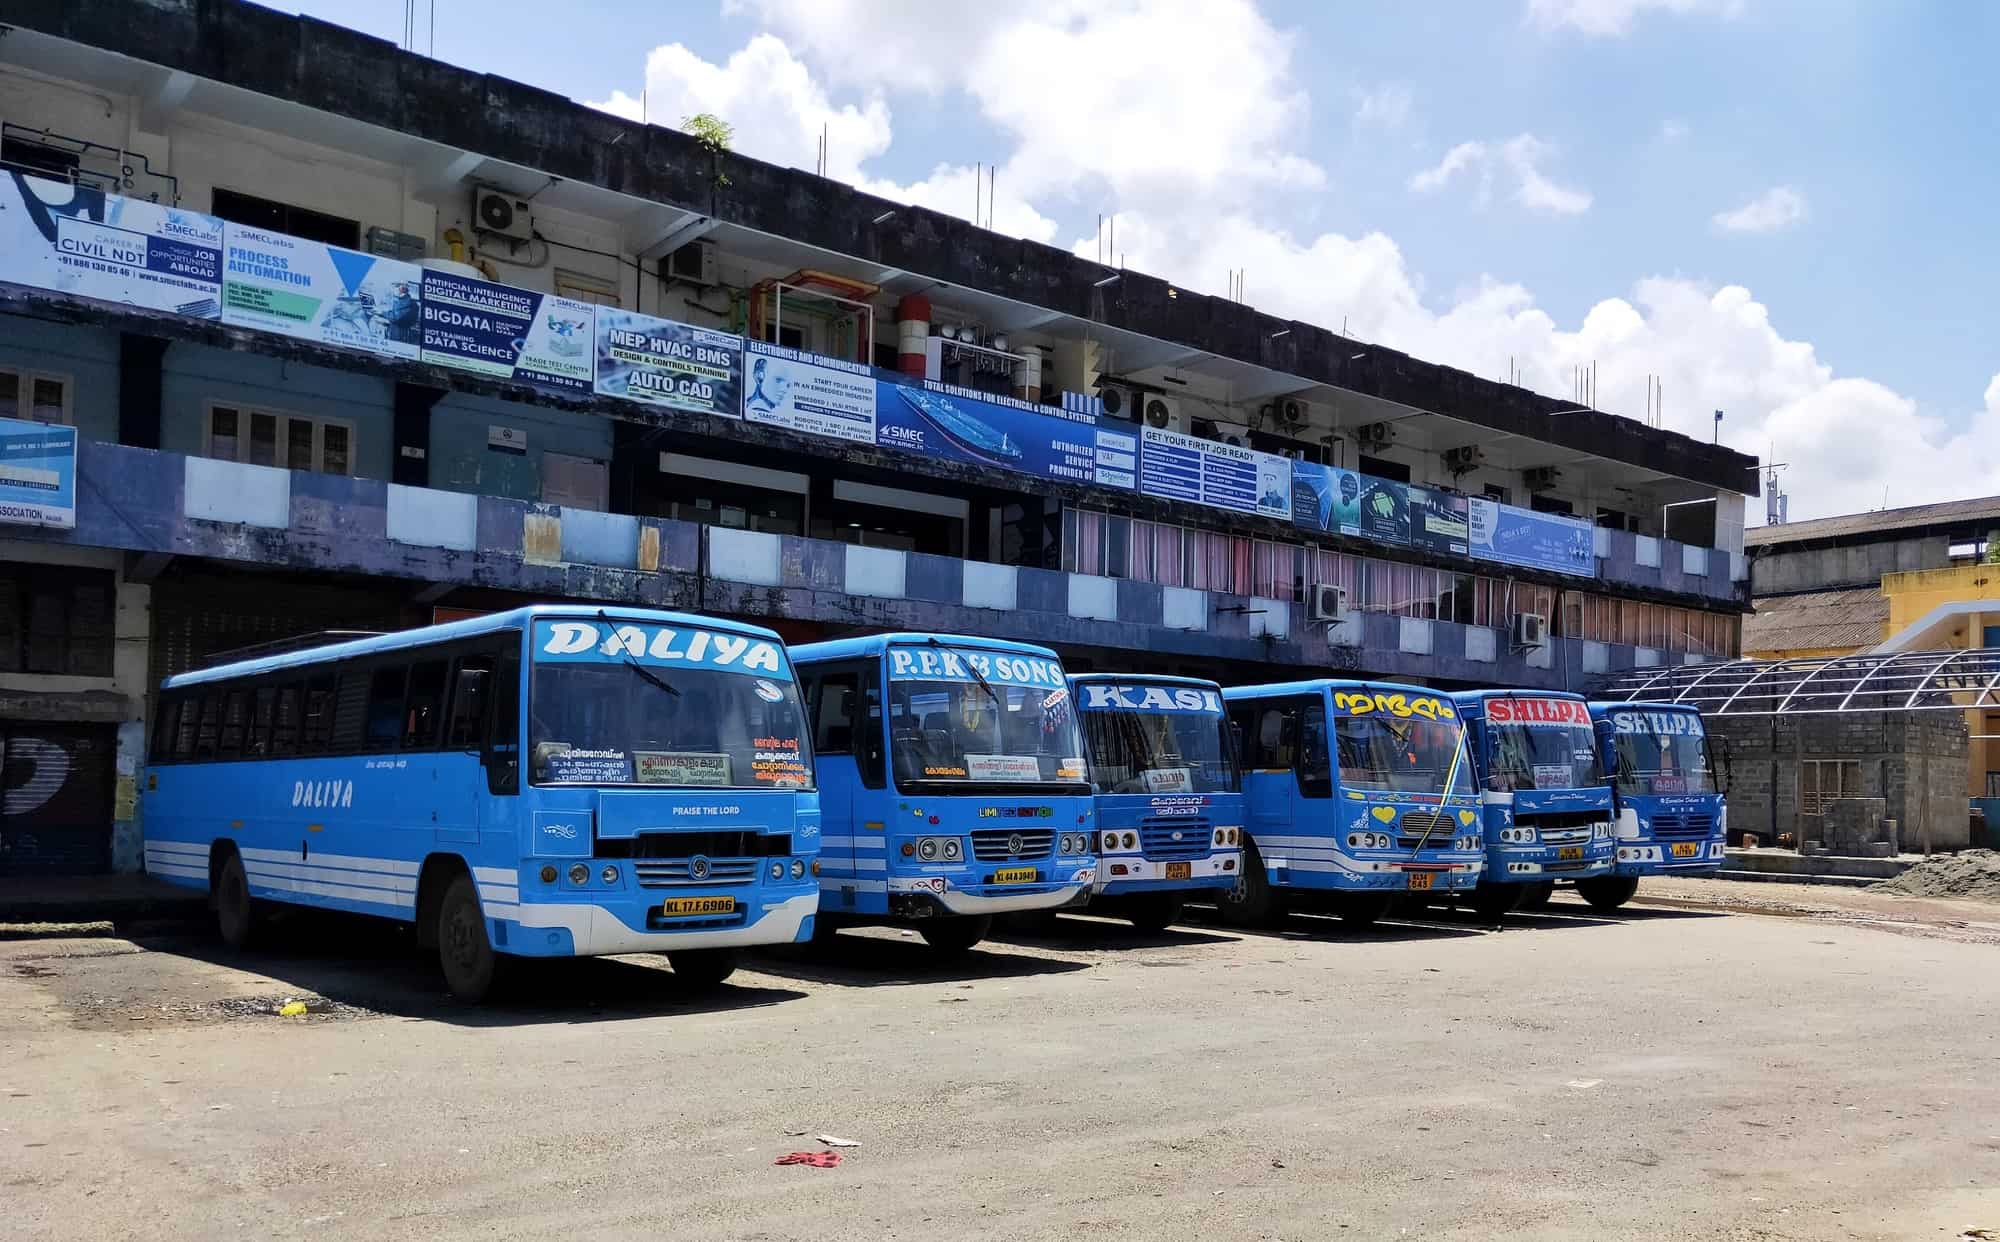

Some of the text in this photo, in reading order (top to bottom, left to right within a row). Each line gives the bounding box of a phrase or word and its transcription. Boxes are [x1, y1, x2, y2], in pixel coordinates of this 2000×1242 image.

[164, 223, 218, 242] SMECLabs
[240, 231, 294, 248] SMECLabs
[61, 238, 145, 264] CIVIL NDT
[150, 249, 216, 270] OPPORTUNITIES
[194, 250, 216, 262] JOB
[230, 246, 288, 270] PROCESS
[170, 262, 215, 278] ABROAD
[228, 260, 311, 287] AUTOMATION
[424, 276, 532, 306] ARTIFICIAL INTELLIGENCE
[424, 284, 466, 300] DIGITAL
[470, 294, 531, 314] MARKETING
[424, 308, 490, 332] BIGDATA
[424, 336, 458, 349] DATA
[462, 341, 513, 360] SCIENCE
[440, 330, 474, 343] TRAINING
[610, 328, 730, 366] MEP HVAC BMS
[614, 351, 642, 362] DESIGN
[652, 357, 692, 372] CONTROLS
[693, 366, 728, 379] TRAINING
[751, 341, 872, 376] ELECTRONICS AND COMMUNICATION
[629, 371, 714, 399] AUTO CAD
[814, 378, 872, 394] START YOUR CAREER
[924, 380, 944, 393] TOTAL
[945, 384, 982, 401] SOLUTIONS
[983, 392, 996, 402] FOR
[996, 394, 1034, 412] ELECTRICAL
[1040, 405, 1068, 419] CONTROL
[1068, 411, 1096, 424] SYSTEMS
[879, 438, 924, 452] www.smec.in
[891, 426, 924, 442] SMEC
[1052, 440, 1094, 457] AUTHORIZED
[1146, 431, 1163, 442] GET
[1164, 434, 1186, 447] YOUR
[1188, 440, 1210, 453] FIRST
[1212, 445, 1228, 457] JOB
[1229, 448, 1255, 462] READY
[1048, 464, 1094, 480] PROVIDER OF
[1065, 454, 1094, 468] SERVICE
[543, 622, 780, 673] DALIYA
[996, 657, 1064, 686] SONS
[1086, 686, 1220, 713] KASI
[1488, 700, 1590, 725] SHILPA
[1613, 712, 1704, 736] SHILPA
[292, 779, 353, 808] DALIYA
[672, 806, 740, 816] PRAISE THE LORD
[666, 898, 733, 914] KL.17.F.6906
